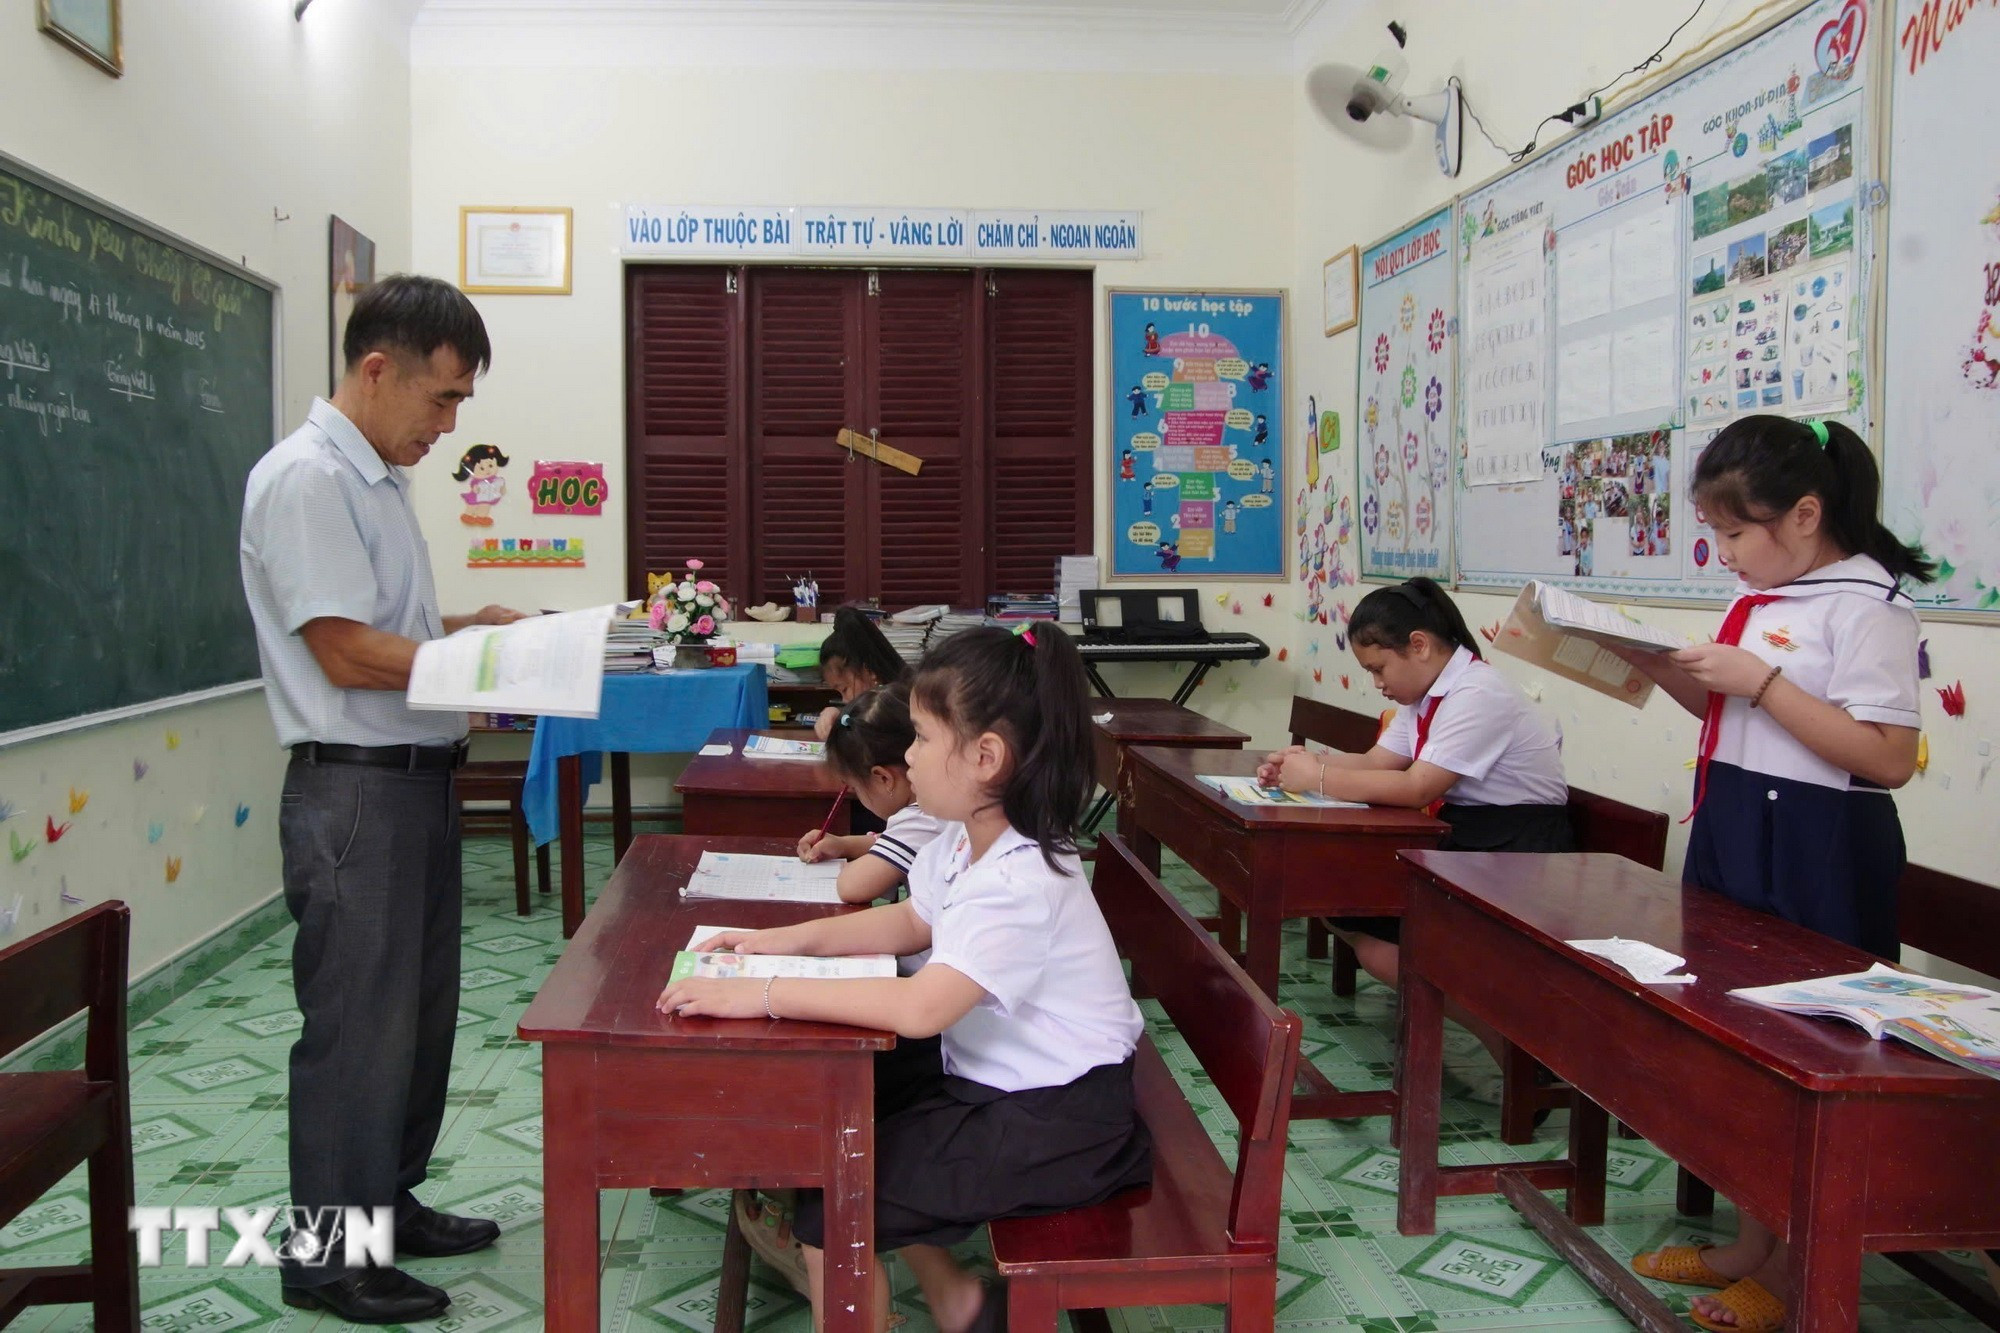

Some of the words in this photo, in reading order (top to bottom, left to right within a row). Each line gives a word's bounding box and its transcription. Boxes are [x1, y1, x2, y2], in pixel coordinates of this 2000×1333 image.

[1567, 152, 1596, 189] GÓC
[1601, 134, 1634, 173] HỌC
[1638, 113, 1673, 154] TẬP
[629, 210, 662, 243] VÀO
[667, 210, 699, 243] LỚP
[704, 212, 758, 249] THUỘC
[763, 212, 790, 244] BÀI
[805, 214, 846, 249] TRẬT
[853, 216, 875, 250] TỰ
[890, 215, 933, 246] VÂNG
[937, 215, 963, 246] LỜI
[978, 218, 1014, 248] CHĂM
[1018, 214, 1038, 248] CHỈ
[1050, 224, 1090, 249] NGOAN
[1095, 218, 1136, 249] NGOÃN
[1374, 251, 1388, 282] NỘI
[1407, 234, 1421, 264] LỚP
[1423, 228, 1440, 257] HỌC
[1143, 297, 1160, 312] 10
[1164, 296, 1197, 312] bước
[1202, 297, 1226, 317] học
[1230, 299, 1253, 317] tập
[1188, 323, 1209, 338] 10
[1154, 393, 1164, 409] 7
[1226, 382, 1237, 398] 8
[1158, 418, 1169, 434] 6
